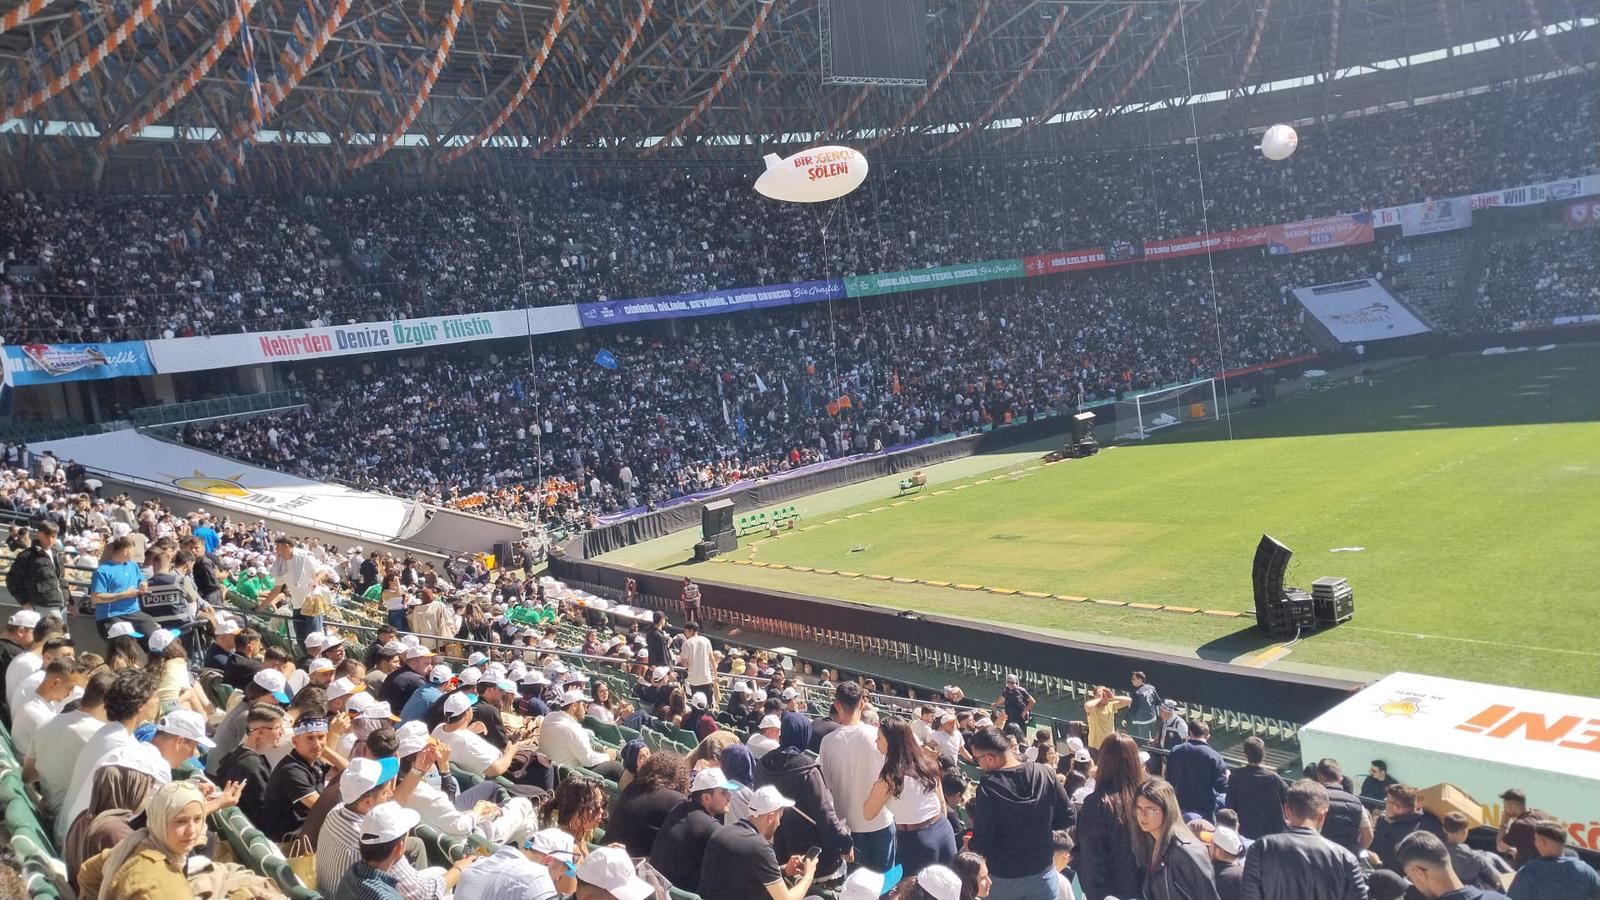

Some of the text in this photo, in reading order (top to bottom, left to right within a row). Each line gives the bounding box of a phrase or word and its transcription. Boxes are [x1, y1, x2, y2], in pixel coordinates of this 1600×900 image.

[794, 155, 813, 168] BİR
[808, 162, 849, 182] ŞÖLENİ
[1503, 188, 1526, 205] Will
[1530, 187, 1545, 201] Be
[792, 287, 809, 298] Bir
[809, 283, 840, 296] Gençlik
[260, 316, 493, 357] Nehirden Denize Özgür Filistin
